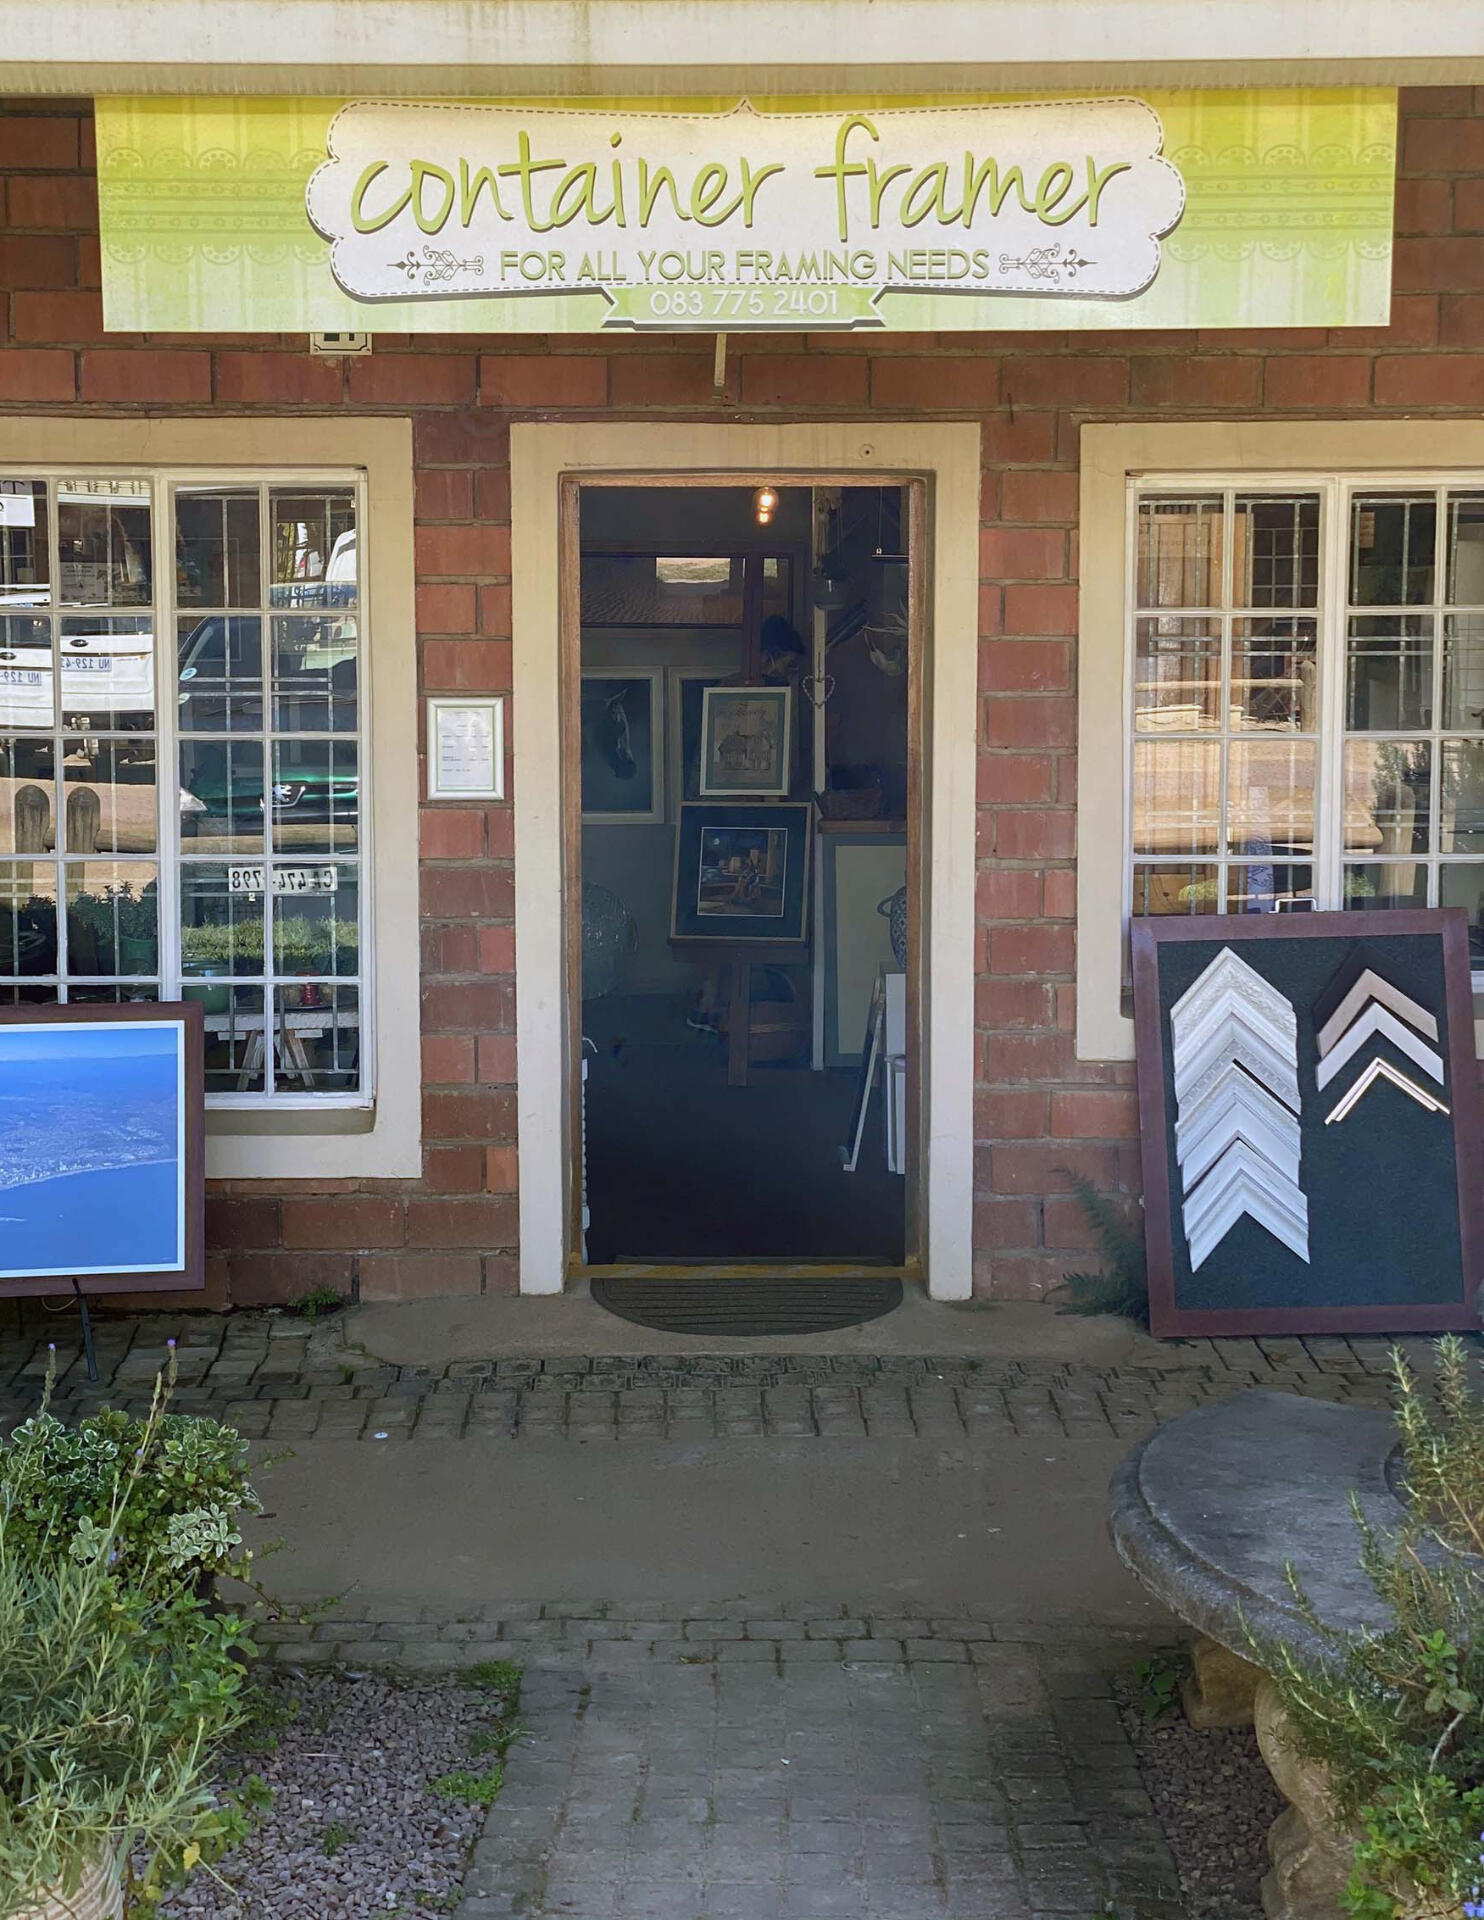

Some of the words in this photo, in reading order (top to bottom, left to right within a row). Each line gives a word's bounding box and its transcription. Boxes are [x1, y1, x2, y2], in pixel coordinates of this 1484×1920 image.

[350, 129, 786, 235] container
[813, 115, 1132, 243] framer
[500, 250, 566, 281] FOR
[577, 250, 627, 281] ALL
[637, 249, 725, 281] YOUR
[735, 249, 877, 281] FRAMING
[887, 248, 990, 281] NEEDS
[650, 290, 704, 317] 083
[711, 289, 765, 316] 775
[772, 288, 838, 316] 2401
